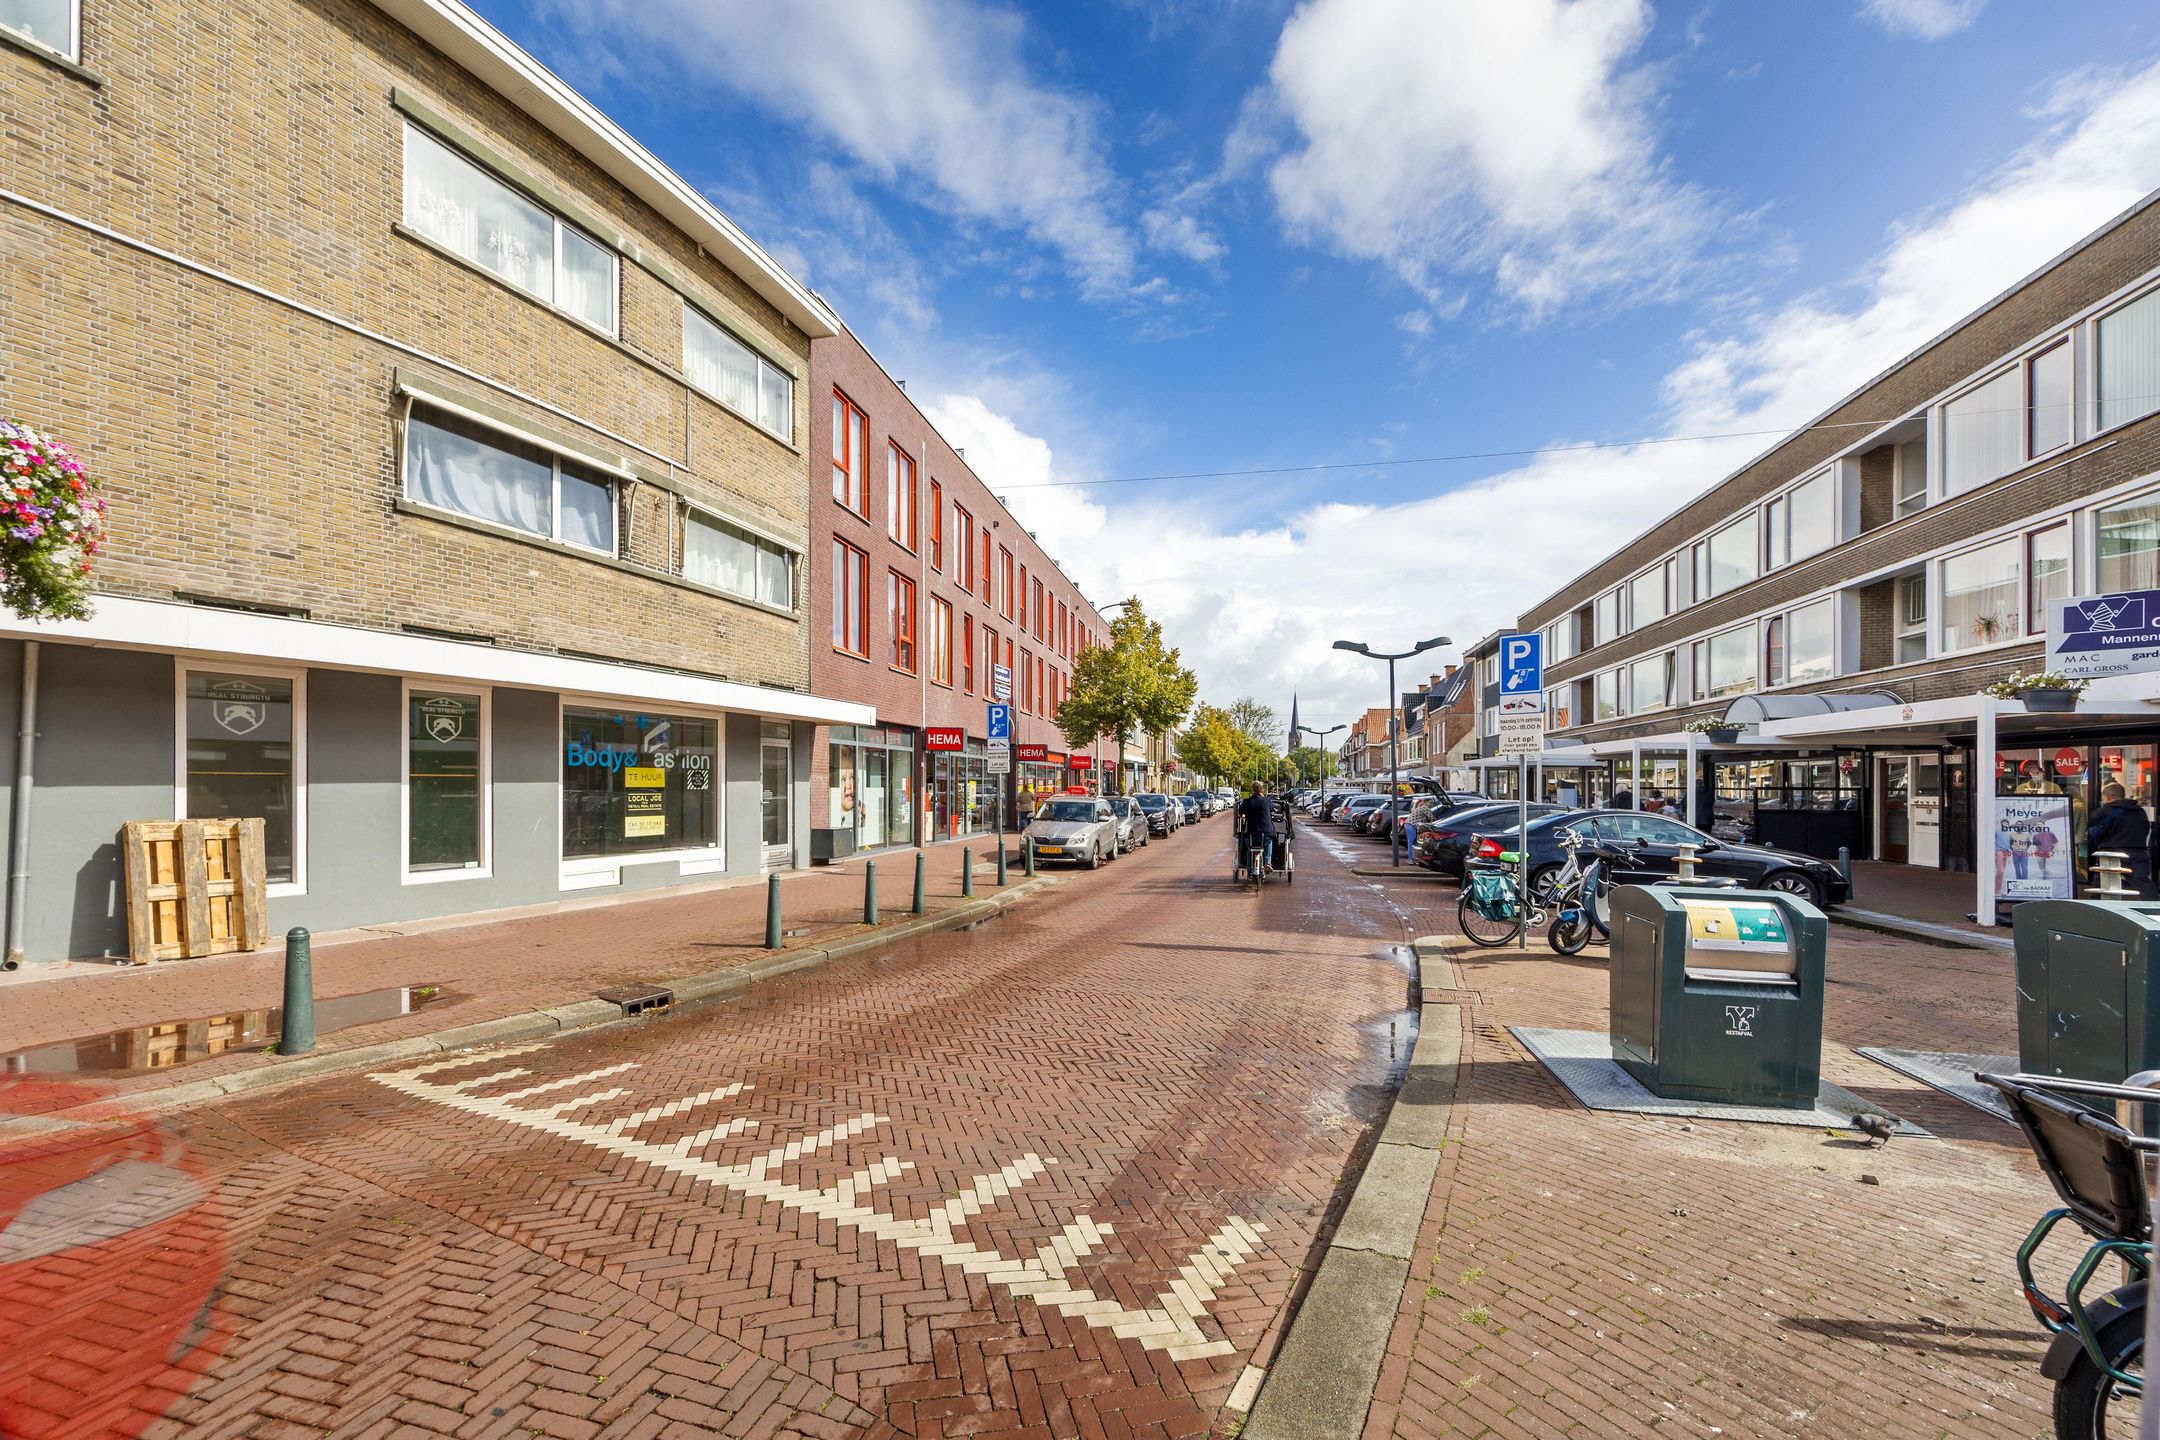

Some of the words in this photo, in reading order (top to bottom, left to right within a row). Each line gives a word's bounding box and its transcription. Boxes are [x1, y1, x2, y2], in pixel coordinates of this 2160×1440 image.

[1509, 640, 1532, 670] P
[2065, 653, 2100, 663] MAC
[2132, 650, 2160, 661] gard
[2064, 666, 2092, 674] CARL
[2094, 664, 2129, 672] GROSS
[207, 691, 228, 699] REAL
[230, 692, 271, 702] STRENGTH
[992, 707, 1003, 724] P
[928, 734, 961, 745] HEMA
[1019, 749, 1045, 758] HEMA
[2056, 757, 2080, 766] SALE
[629, 773, 638, 781] TE
[641, 773, 663, 781] HUUR
[2006, 808, 2043, 819] Meyer
[2001, 824, 2050, 833] broeken
